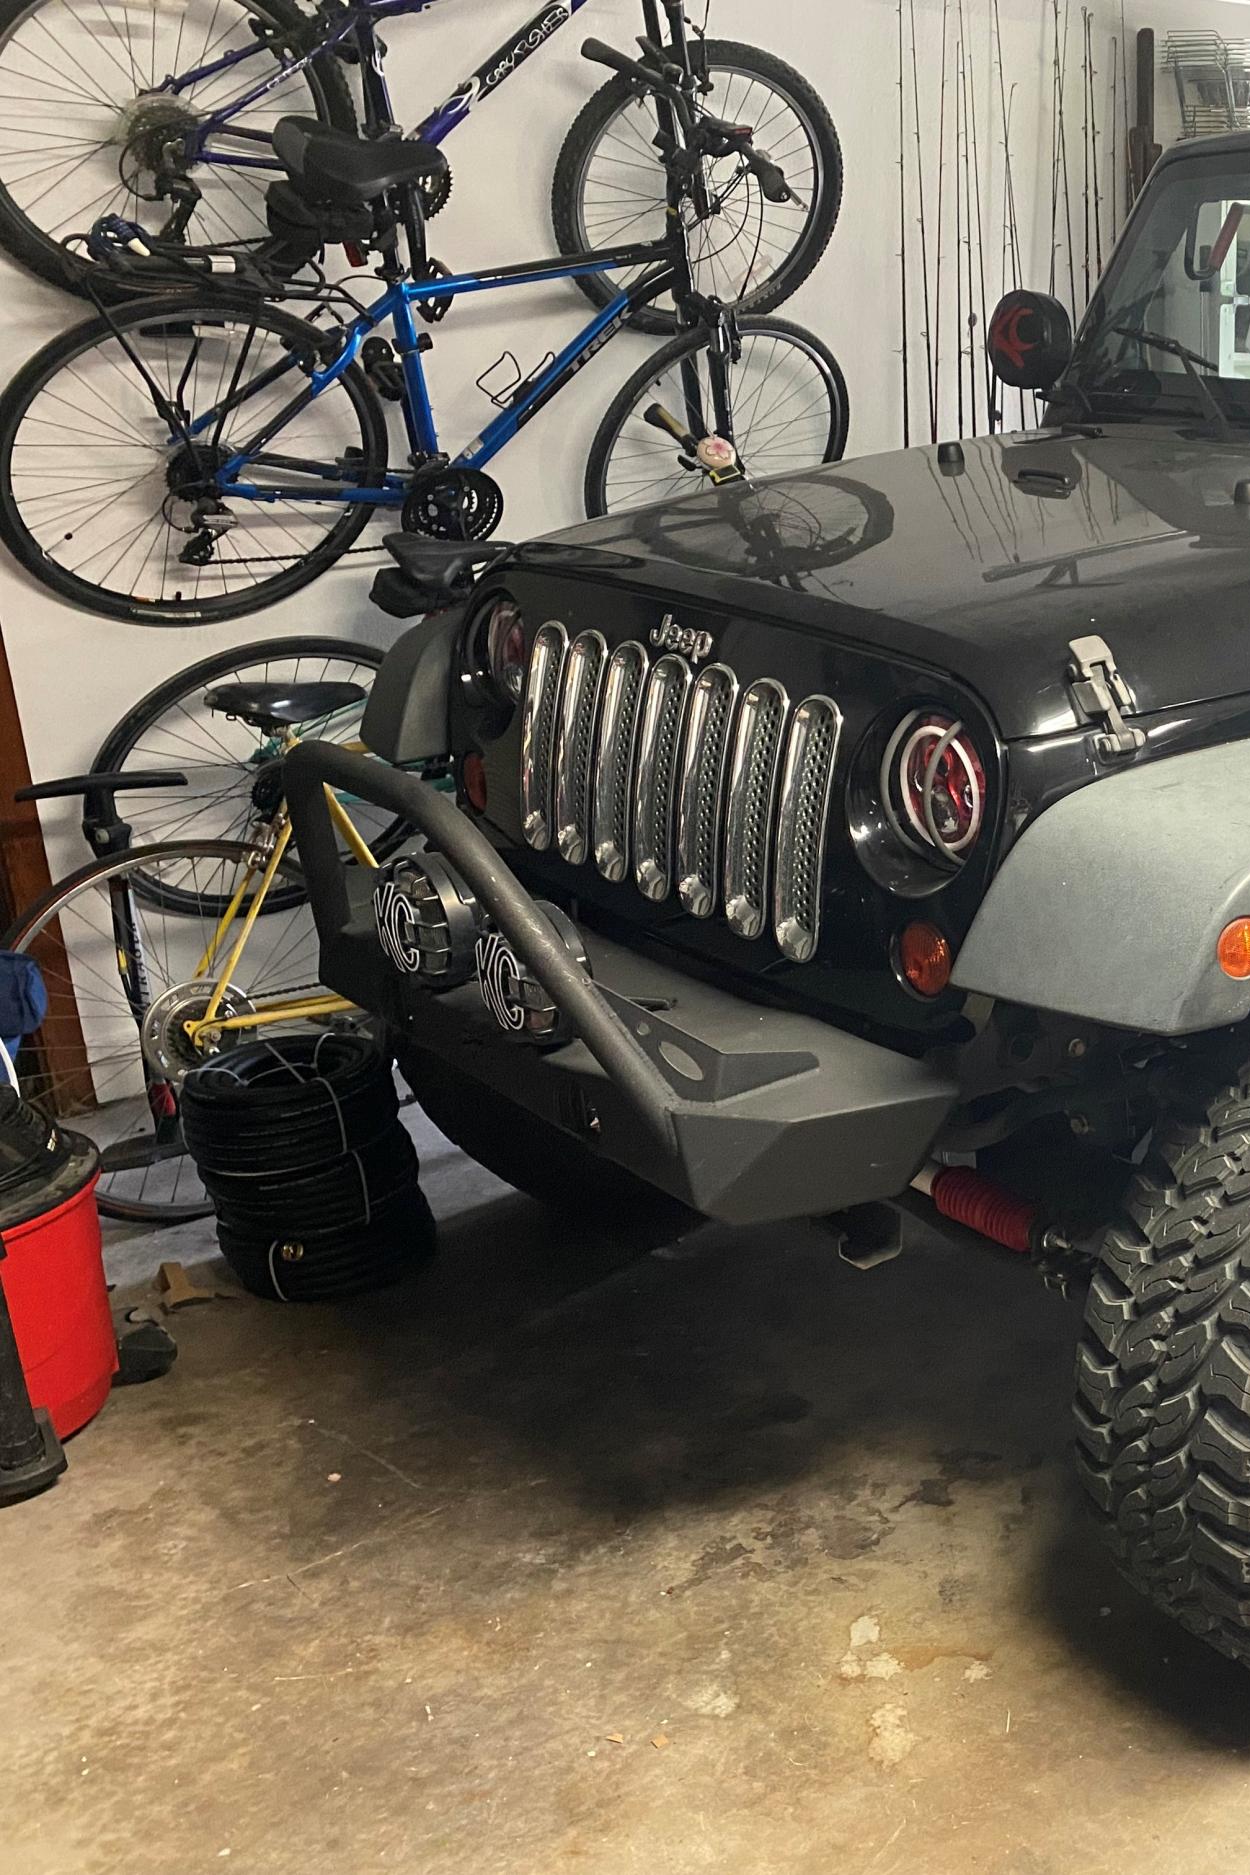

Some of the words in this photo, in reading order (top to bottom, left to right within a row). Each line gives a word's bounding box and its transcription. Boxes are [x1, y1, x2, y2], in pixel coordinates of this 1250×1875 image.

[570, 305, 633, 373] TREK
[649, 613, 713, 664] Jeep
[373, 882, 420, 973] KC
[475, 934, 524, 1030] KC
